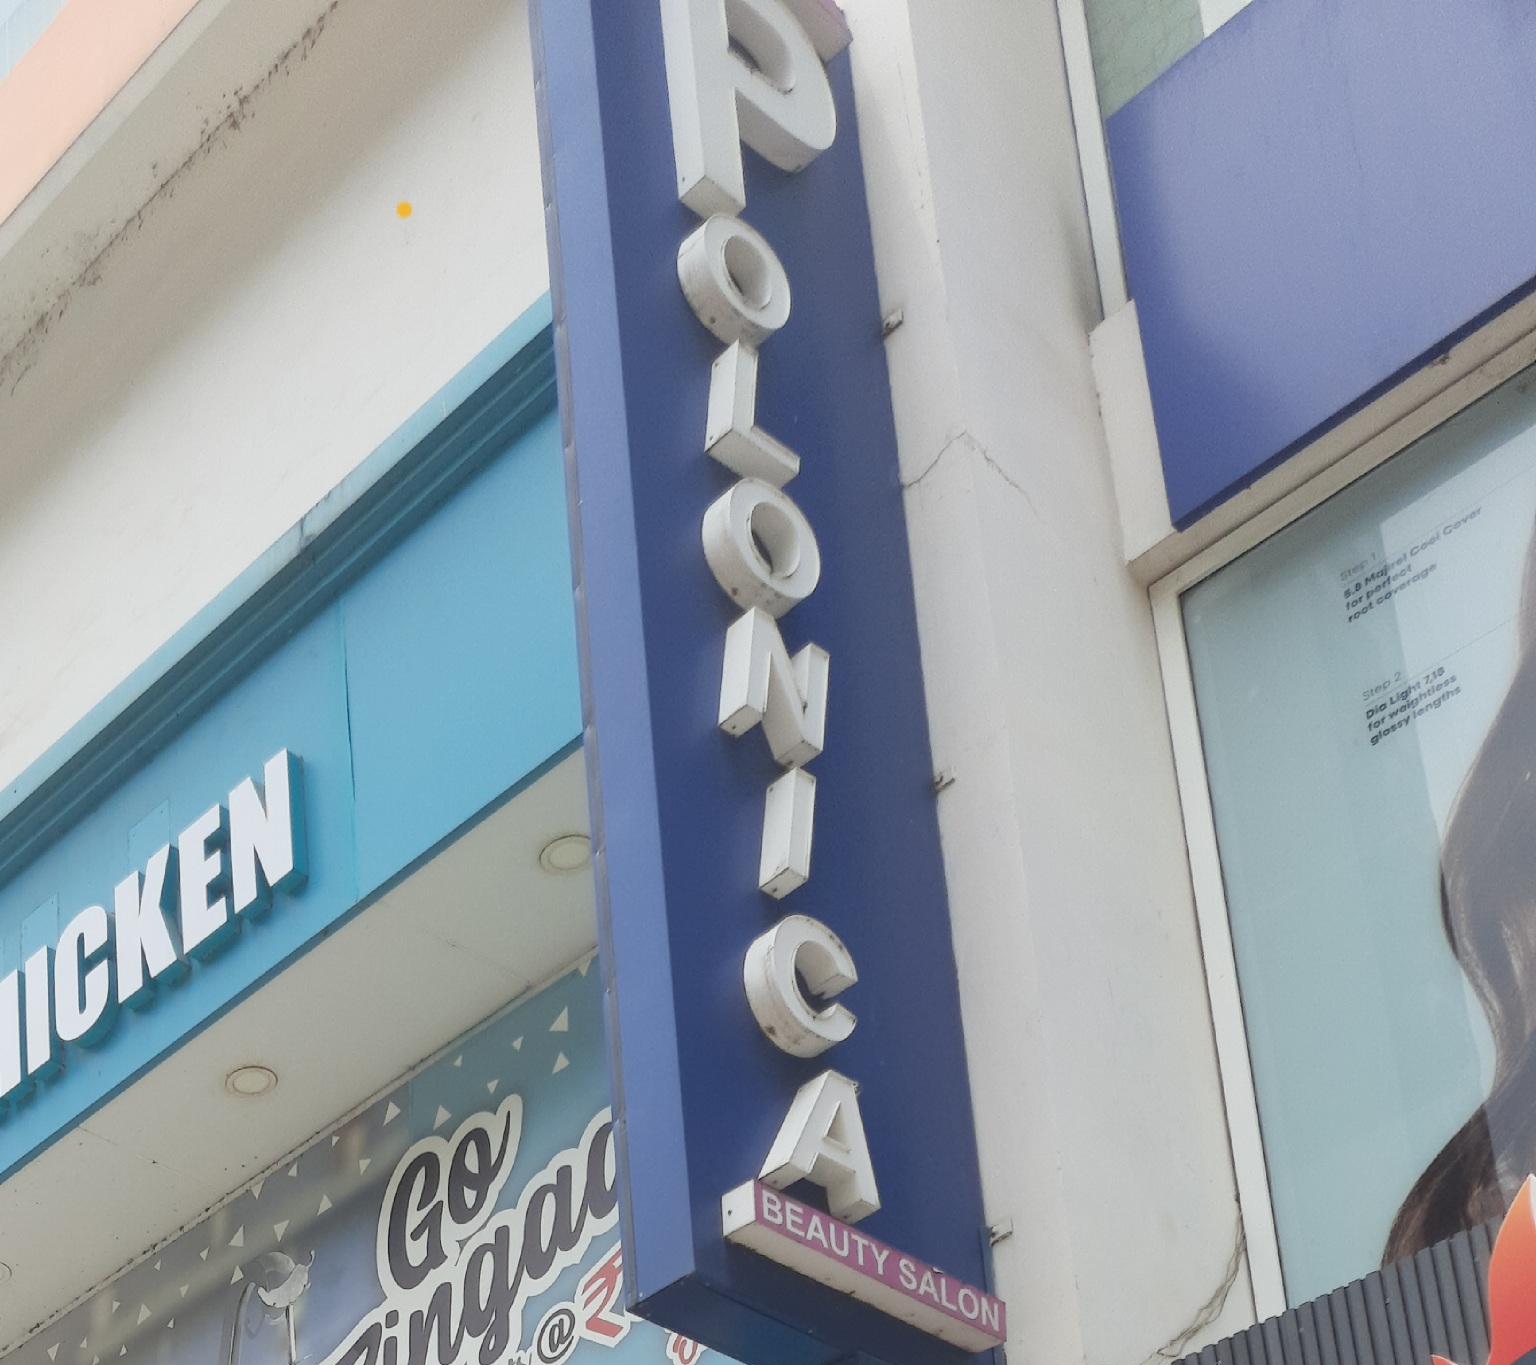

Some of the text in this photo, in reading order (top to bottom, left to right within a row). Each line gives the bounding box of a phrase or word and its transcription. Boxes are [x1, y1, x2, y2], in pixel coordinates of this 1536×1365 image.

[665, 0, 881, 1217] POLONICA
[388, 1110, 511, 1290] Go
[761, 1189, 1000, 1332] BEAUTY SALON
